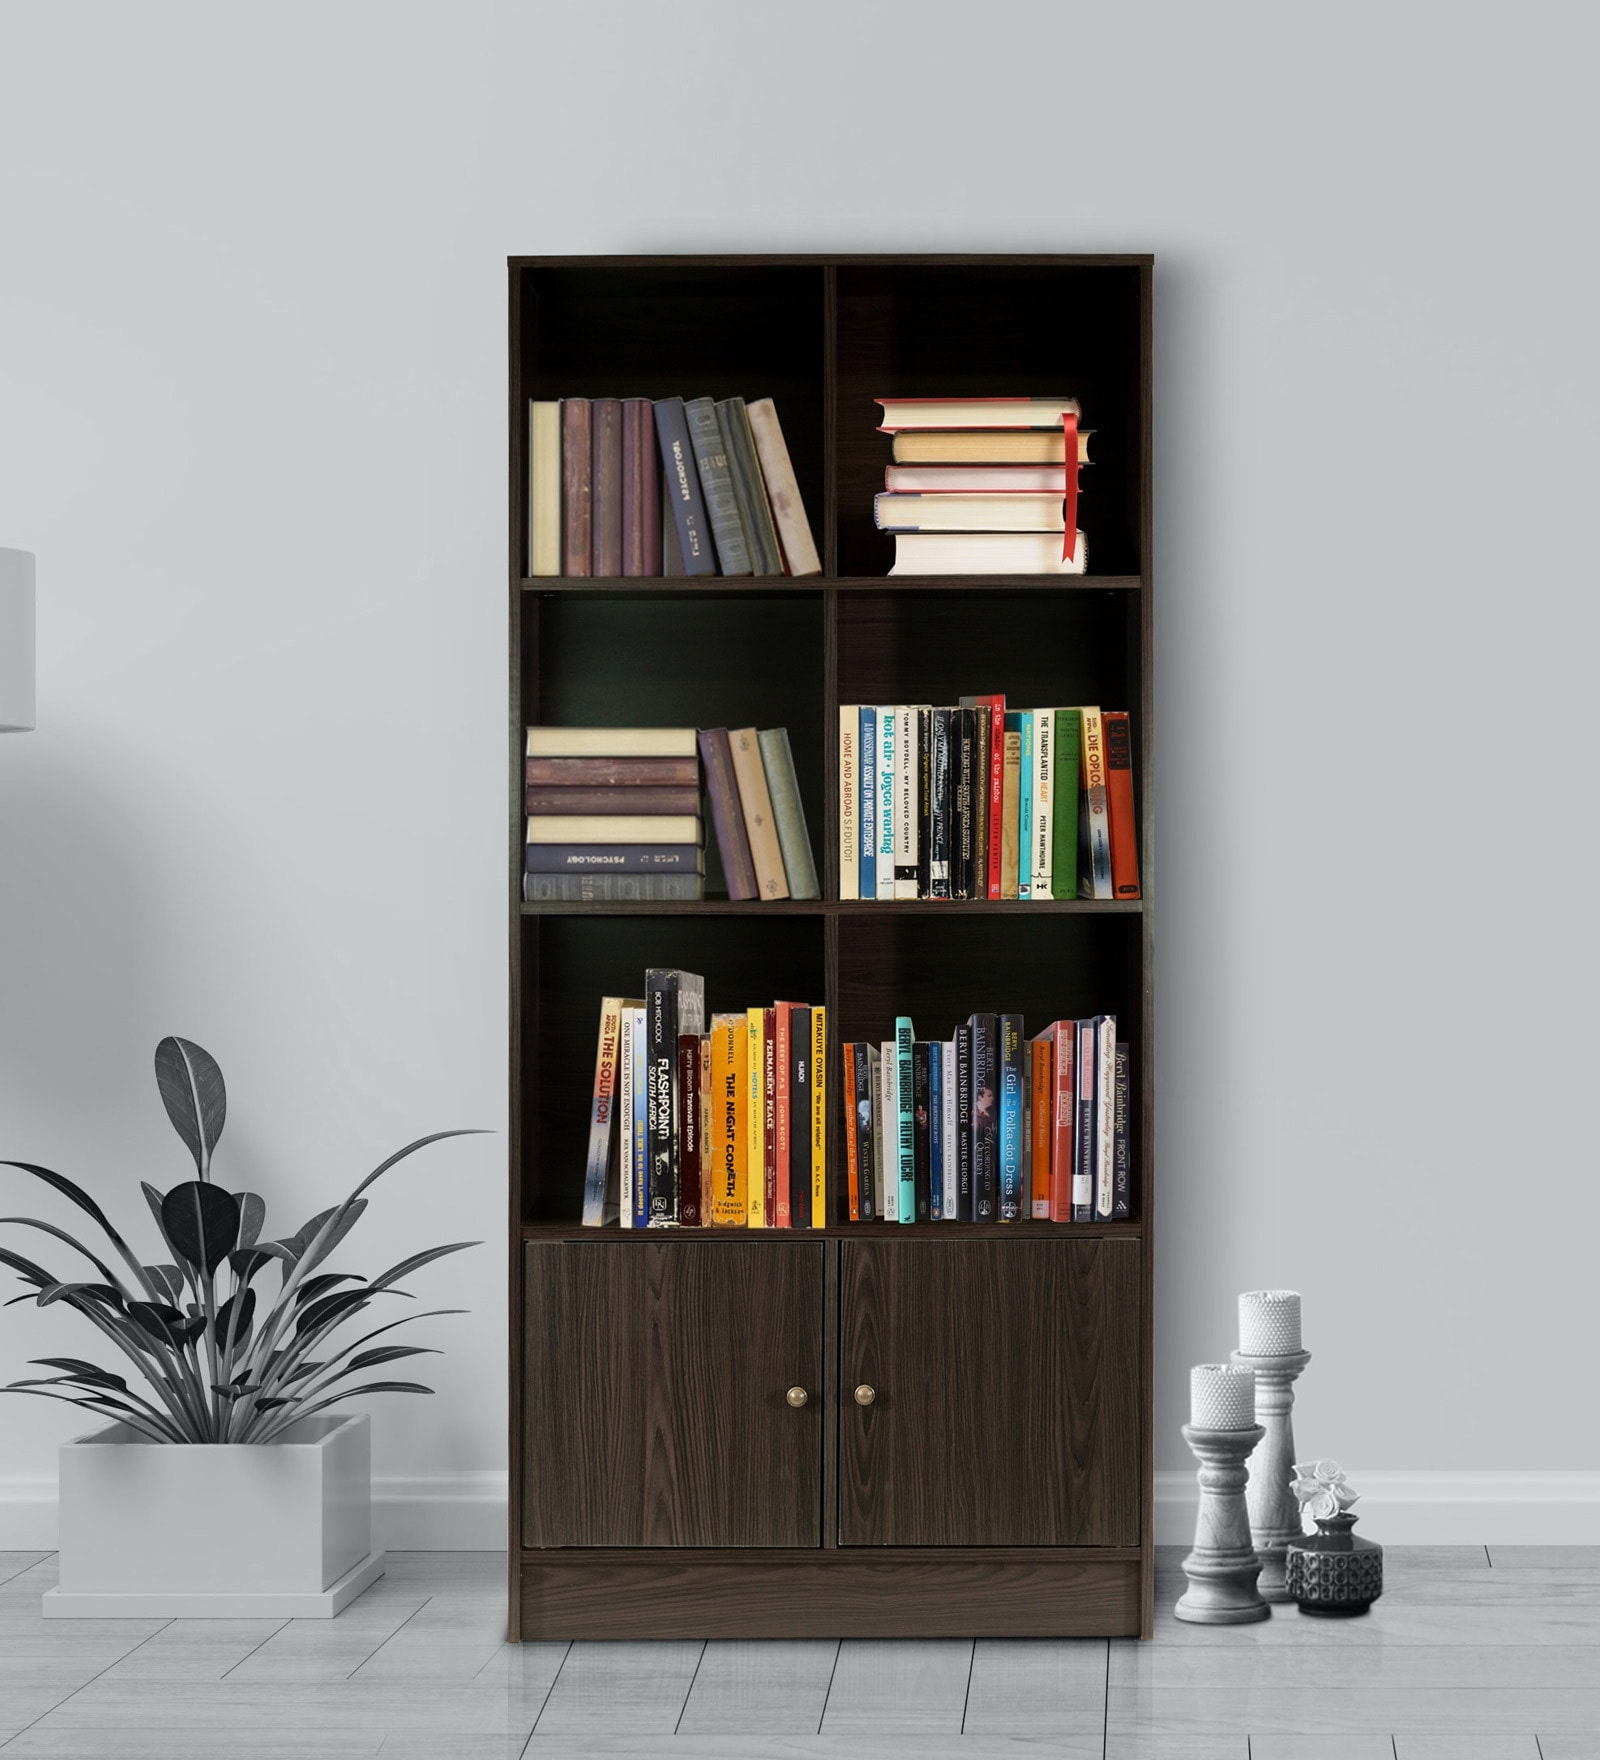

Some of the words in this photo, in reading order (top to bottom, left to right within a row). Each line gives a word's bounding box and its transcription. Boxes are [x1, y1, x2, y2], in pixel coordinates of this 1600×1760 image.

[995, 704, 1001, 712] in
[884, 715, 895, 738] hot
[1040, 716, 1048, 728] THE
[844, 733, 852, 758] HOME
[884, 741, 895, 760] air
[962, 738, 970, 751] HOW
[1040, 731, 1048, 780] TRANSPLANTED
[1088, 735, 1099, 752] DIE
[844, 760, 852, 779] AND
[962, 752, 970, 768] LONG
[863, 765, 874, 789] ASSAULT
[880, 771, 895, 806] joyce
[904, 775, 909, 785] MY
[962, 768, 970, 784] WILL
[1090, 754, 1103, 815] OPLOSSING
[844, 781, 852, 817] ABROAD
[863, 790, 874, 798] ON
[962, 783, 970, 805] SOUTH
[1040, 782, 1048, 803] HEART
[863, 799, 874, 822] PRIVATE
[962, 806, 970, 828] AFRICA
[863, 823, 874, 857] ENTERPRISE
[880, 809, 894, 854] waring
[936, 822, 944, 845] PRINCE
[566, 856, 625, 865] PSYCHOLOGY
[602, 1036, 615, 1058] THE
[898, 1028, 911, 1055] BERYL
[959, 1029, 968, 1060] BERYL
[1104, 1022, 1113, 1058] Something
[779, 1065, 785, 1074] OF
[976, 1027, 985, 1092] BAINBRIDGE
[986, 1047, 994, 1073] BERYL
[1115, 1053, 1127, 1078] Beryl
[596, 1061, 612, 1124] SOLUTION
[648, 1066, 657, 1098] SOUTH
[726, 1073, 736, 1098] THE
[899, 1060, 912, 1114] BAINBRIDGE
[960, 1063, 968, 1124] BAINBRIDGE
[1006, 1074, 1016, 1094] Girl
[658, 1058, 670, 1139] FLASHPOINT!
[1115, 1082, 1127, 1135] Bainbridge
[648, 1098, 657, 1130] AFRICA
[1102, 1100, 1113, 1137] Yesterday
[686, 1125, 694, 1152] Episode
[848, 1140, 855, 1149] of
[900, 1121, 913, 1150] FILTHY
[1006, 1110, 1016, 1160] Polka-dot
[1117, 1139, 1126, 1168] FRONT
[726, 1144, 736, 1197] COMETH
[900, 1154, 913, 1182] LUCRE
[1005, 1165, 1016, 1195] Dress
[985, 1181, 991, 1190] TO
[1117, 1171, 1126, 1192] ROW
